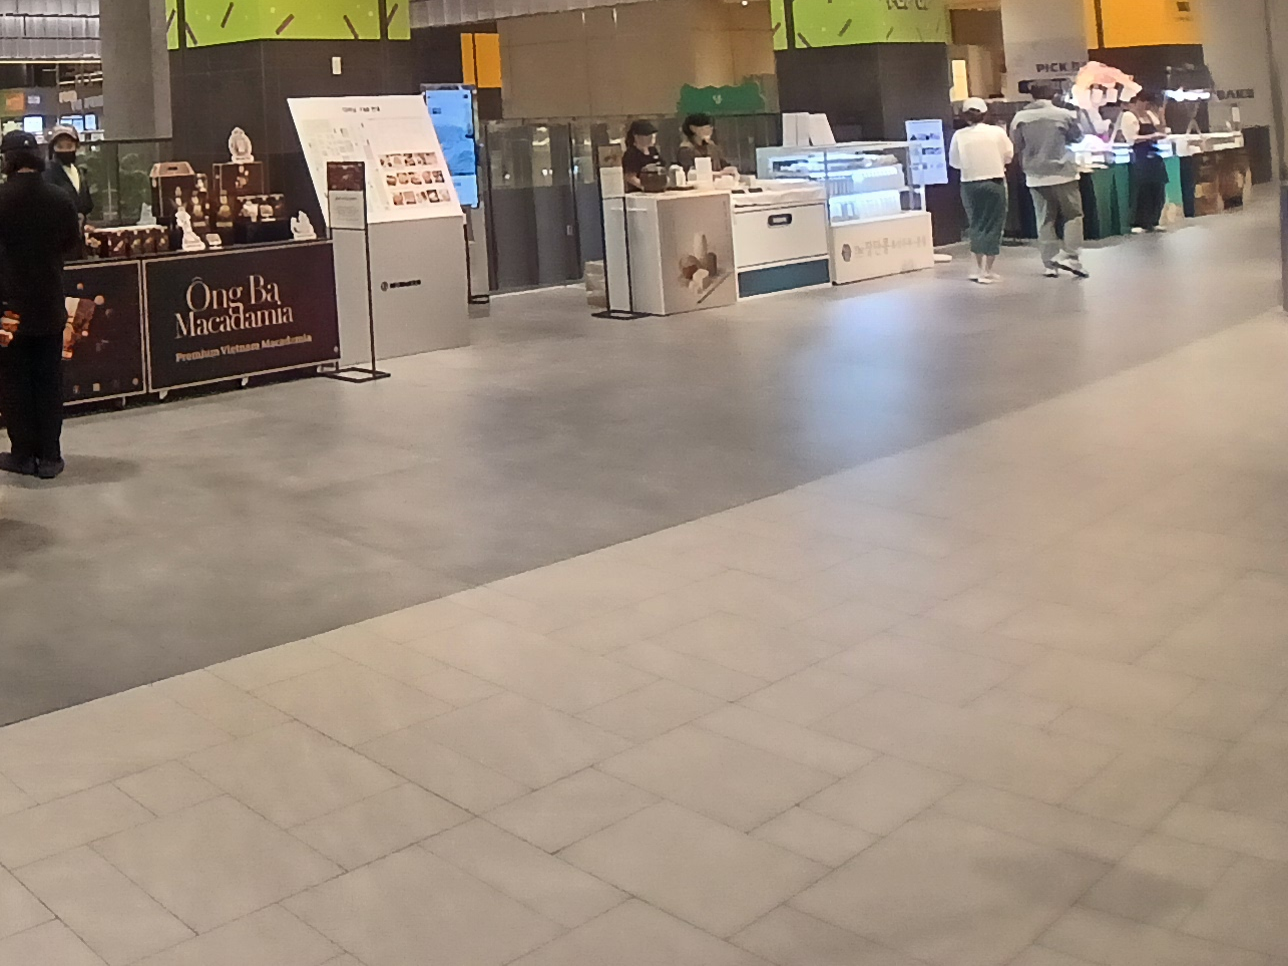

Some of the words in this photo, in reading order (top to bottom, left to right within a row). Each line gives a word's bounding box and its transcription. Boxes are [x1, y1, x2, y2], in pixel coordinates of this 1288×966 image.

[1035, 62, 1067, 73] PICK
[174, 306, 294, 339] Macadamia
[175, 348, 220, 362] Premium
[221, 342, 261, 355] Vietnam
[261, 333, 313, 349] Macadamia
